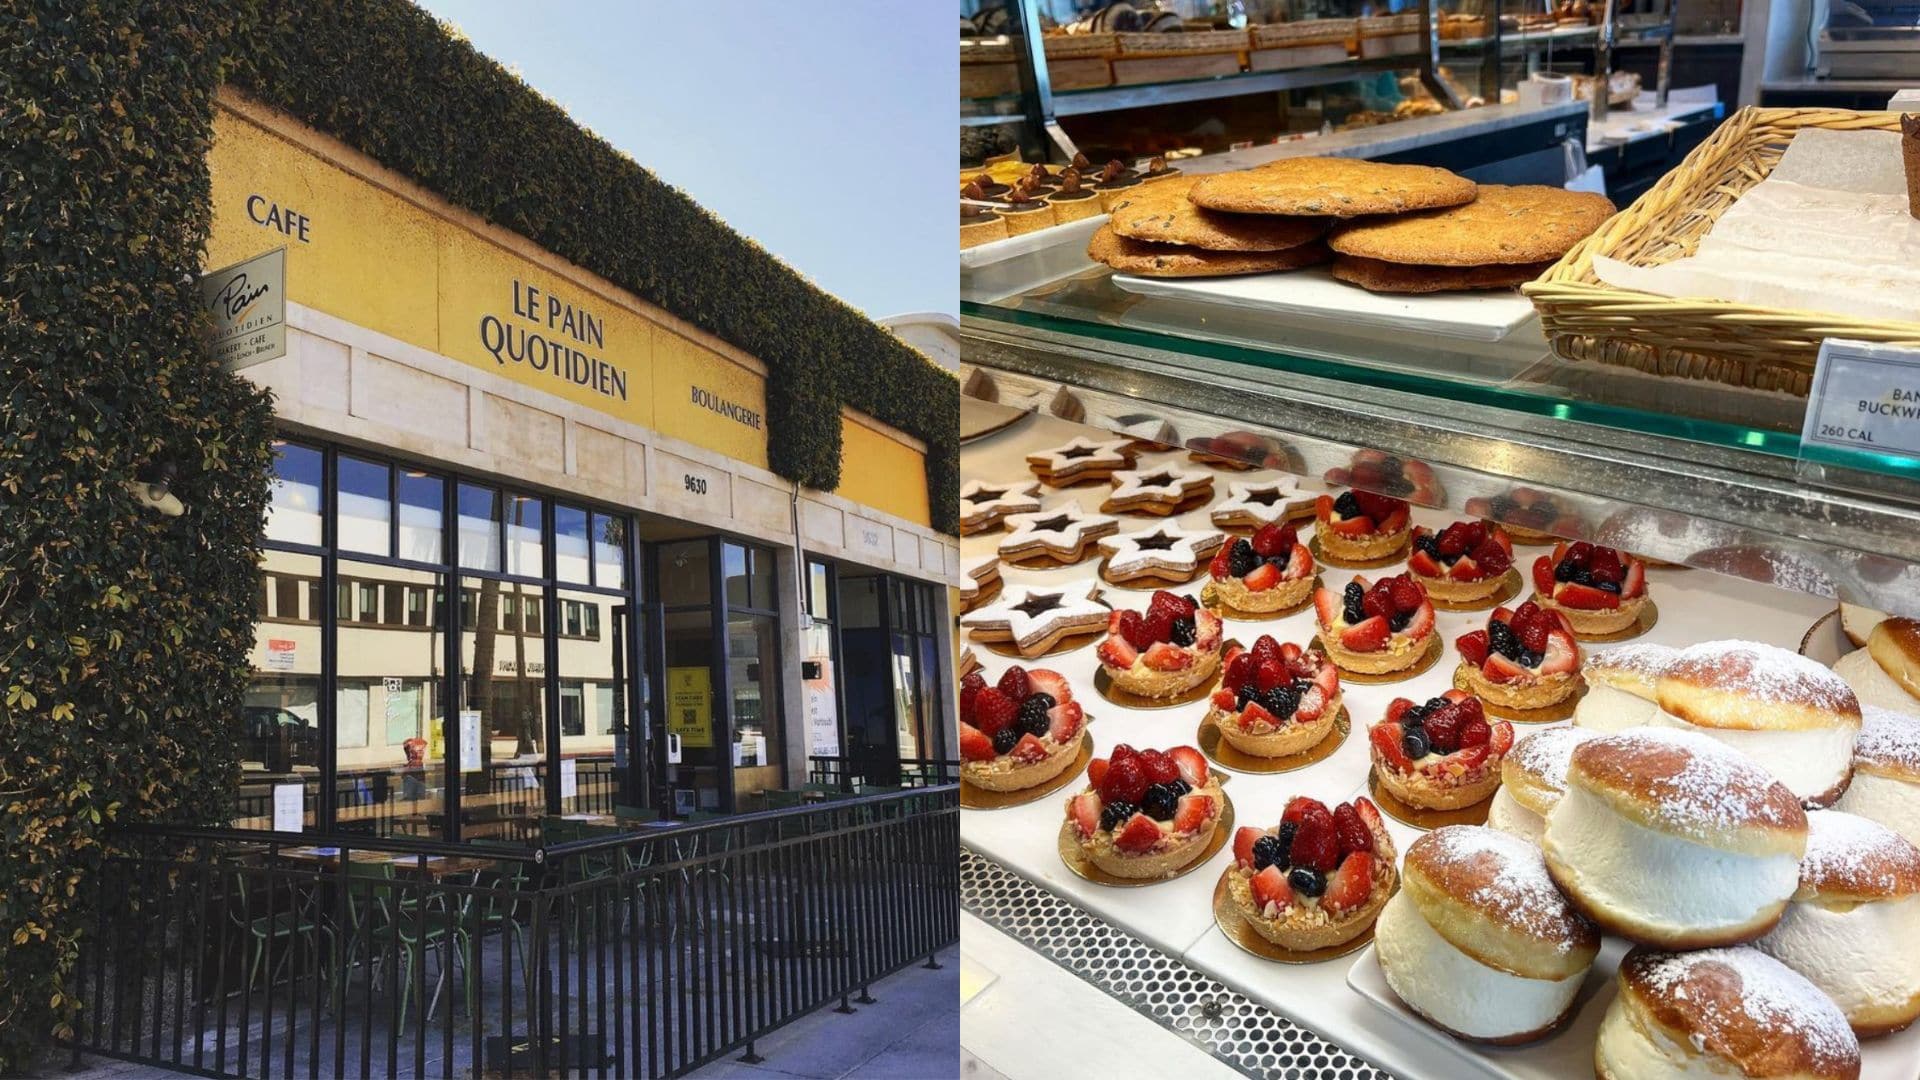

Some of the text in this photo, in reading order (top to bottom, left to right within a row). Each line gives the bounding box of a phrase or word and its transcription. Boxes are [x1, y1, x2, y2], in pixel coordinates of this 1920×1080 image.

[246, 194, 310, 243] CAFE
[211, 273, 269, 320] Pain
[512, 279, 603, 349] LE PAIN
[480, 315, 627, 401] QUOTIDIEN
[691, 385, 761, 430] BOULANGERIE
[1857, 400, 1920, 419] BUCKW
[1821, 424, 1874, 442] 260 CAL
[684, 474, 707, 495] 9630
